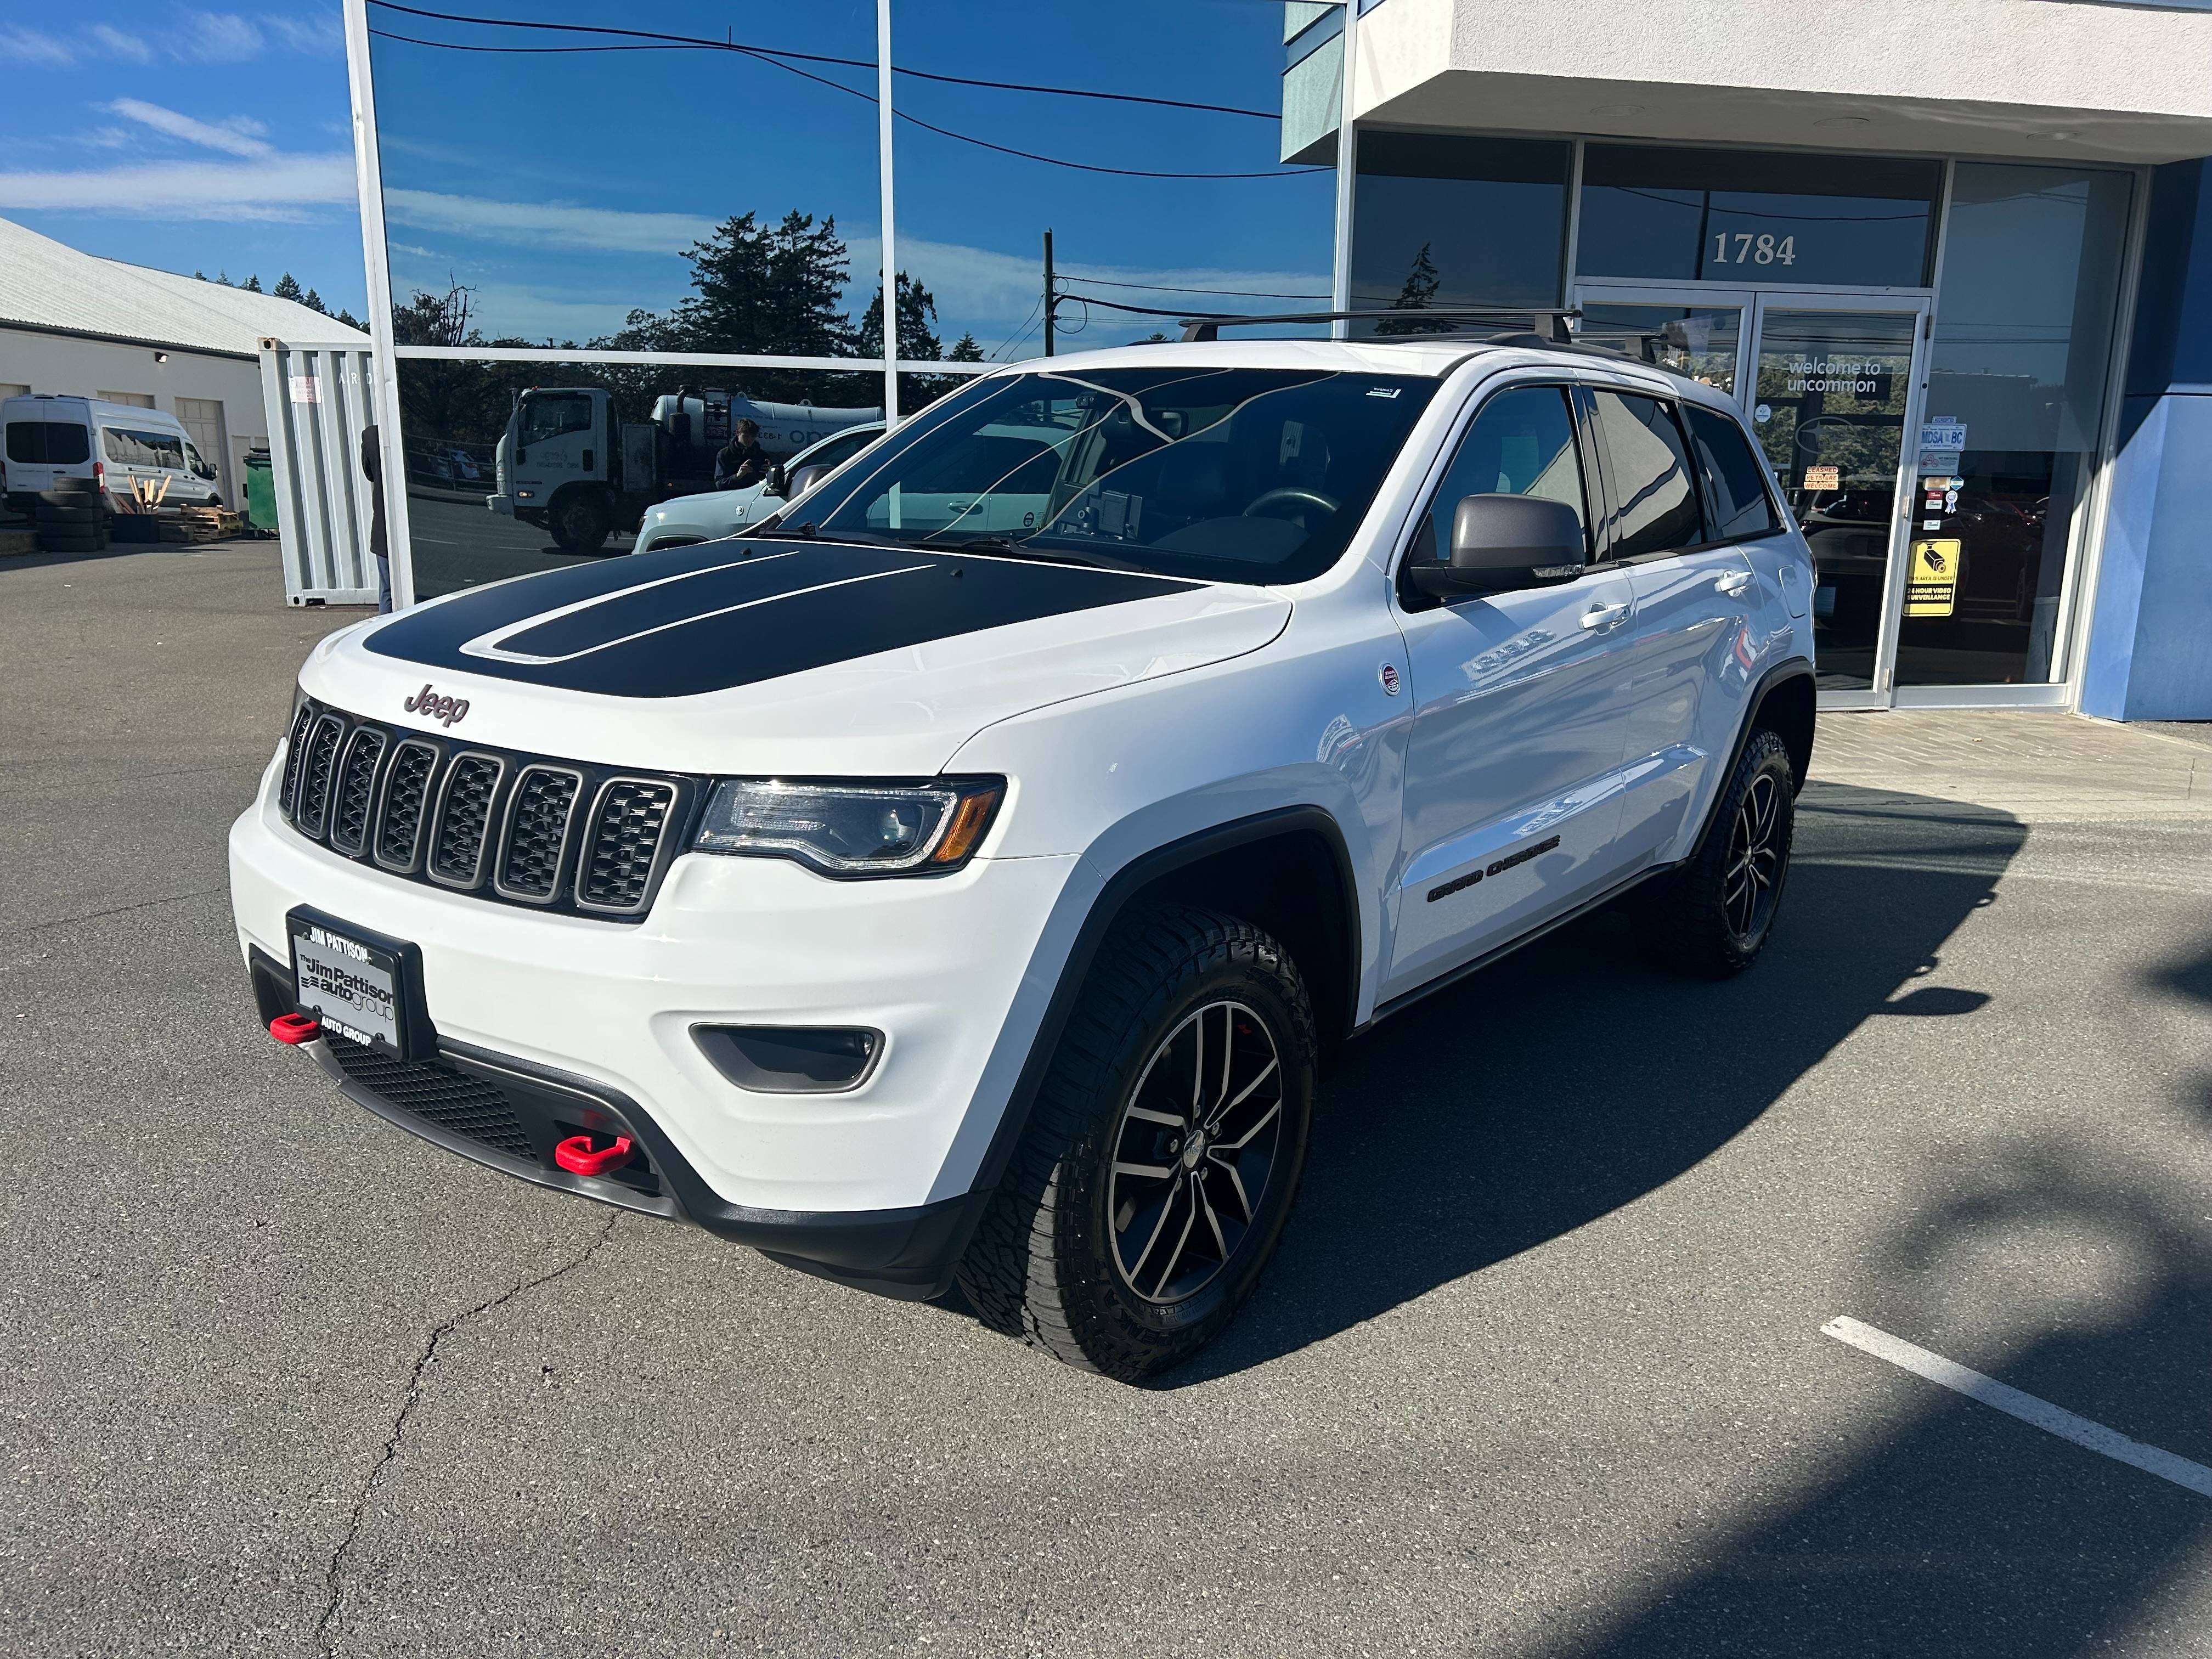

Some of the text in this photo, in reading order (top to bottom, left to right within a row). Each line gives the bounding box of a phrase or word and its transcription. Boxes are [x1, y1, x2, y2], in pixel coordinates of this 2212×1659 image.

[1713, 233, 1796, 266] 1784
[1789, 357, 1881, 375] welcome to
[1787, 379, 1876, 392] uncommon
[1922, 431, 1962, 444] MDSA BC
[404, 684, 470, 729] Jeep
[1427, 834, 1561, 902] GRAND CHEROKEE
[310, 927, 368, 963] JIM PATTISON
[300, 954, 311, 967] The
[321, 1016, 371, 1046] AUTO GROUP
